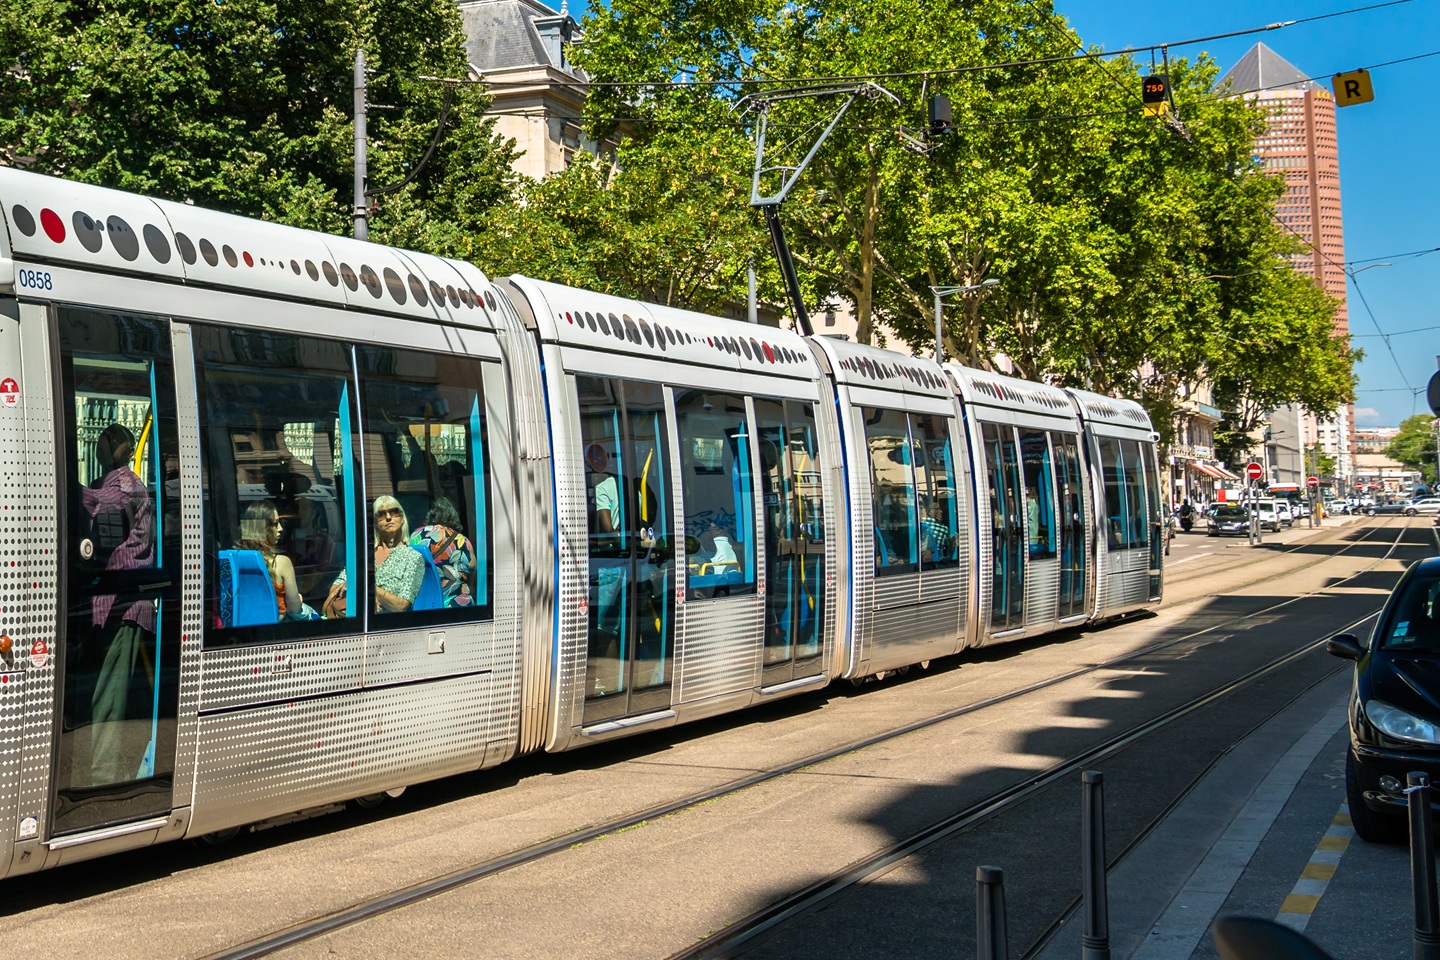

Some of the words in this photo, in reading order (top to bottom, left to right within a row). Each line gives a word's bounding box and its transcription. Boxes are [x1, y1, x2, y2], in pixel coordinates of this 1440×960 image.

[1146, 83, 1164, 93] 750
[1344, 79, 1361, 99] R
[18, 267, 53, 292] 0858
